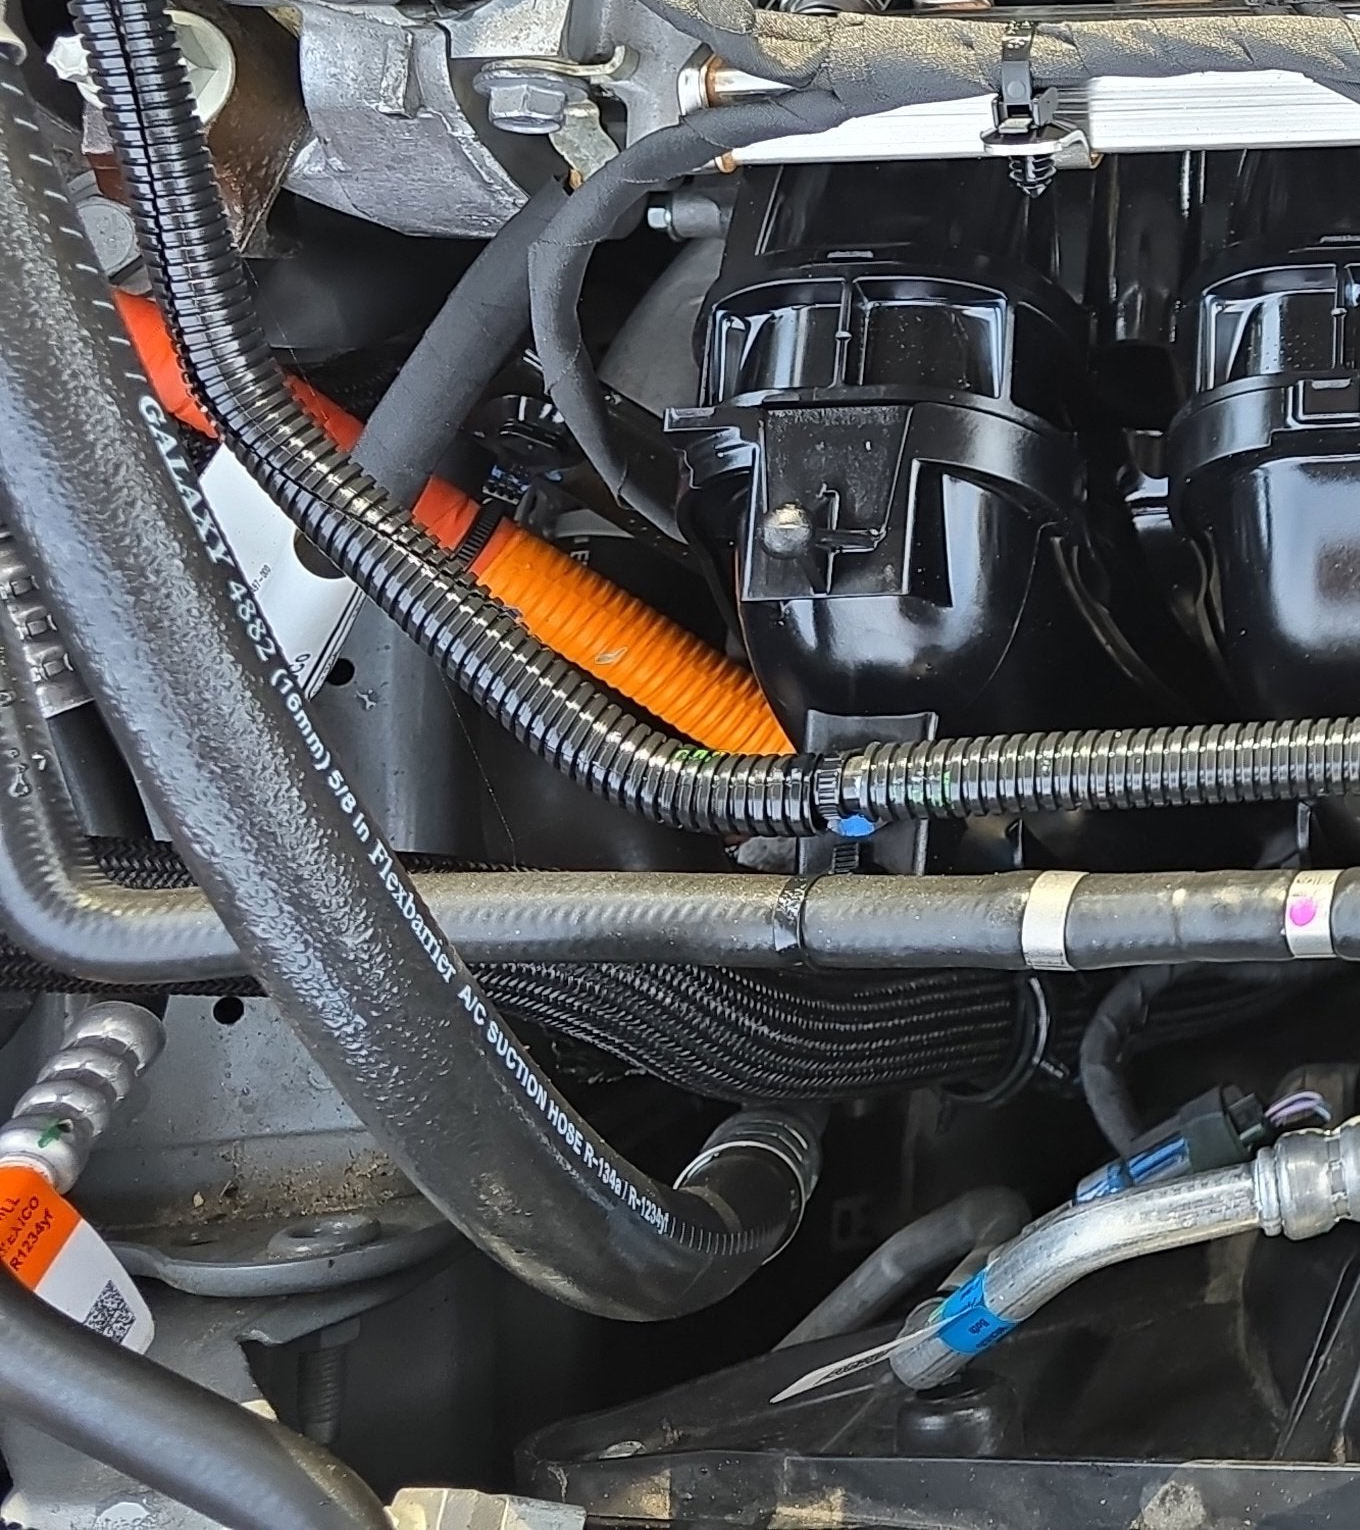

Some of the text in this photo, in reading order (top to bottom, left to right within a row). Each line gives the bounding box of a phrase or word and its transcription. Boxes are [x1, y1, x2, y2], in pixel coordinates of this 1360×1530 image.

[138, 395, 236, 567] GALAXY
[227, 579, 278, 663] 4882
[270, 668, 331, 770] (16mm)
[457, 984, 488, 1026] A/C
[486, 1020, 548, 1111] SUCTION
[547, 1099, 584, 1156] HOSE
[583, 1141, 621, 1196] R-134a
